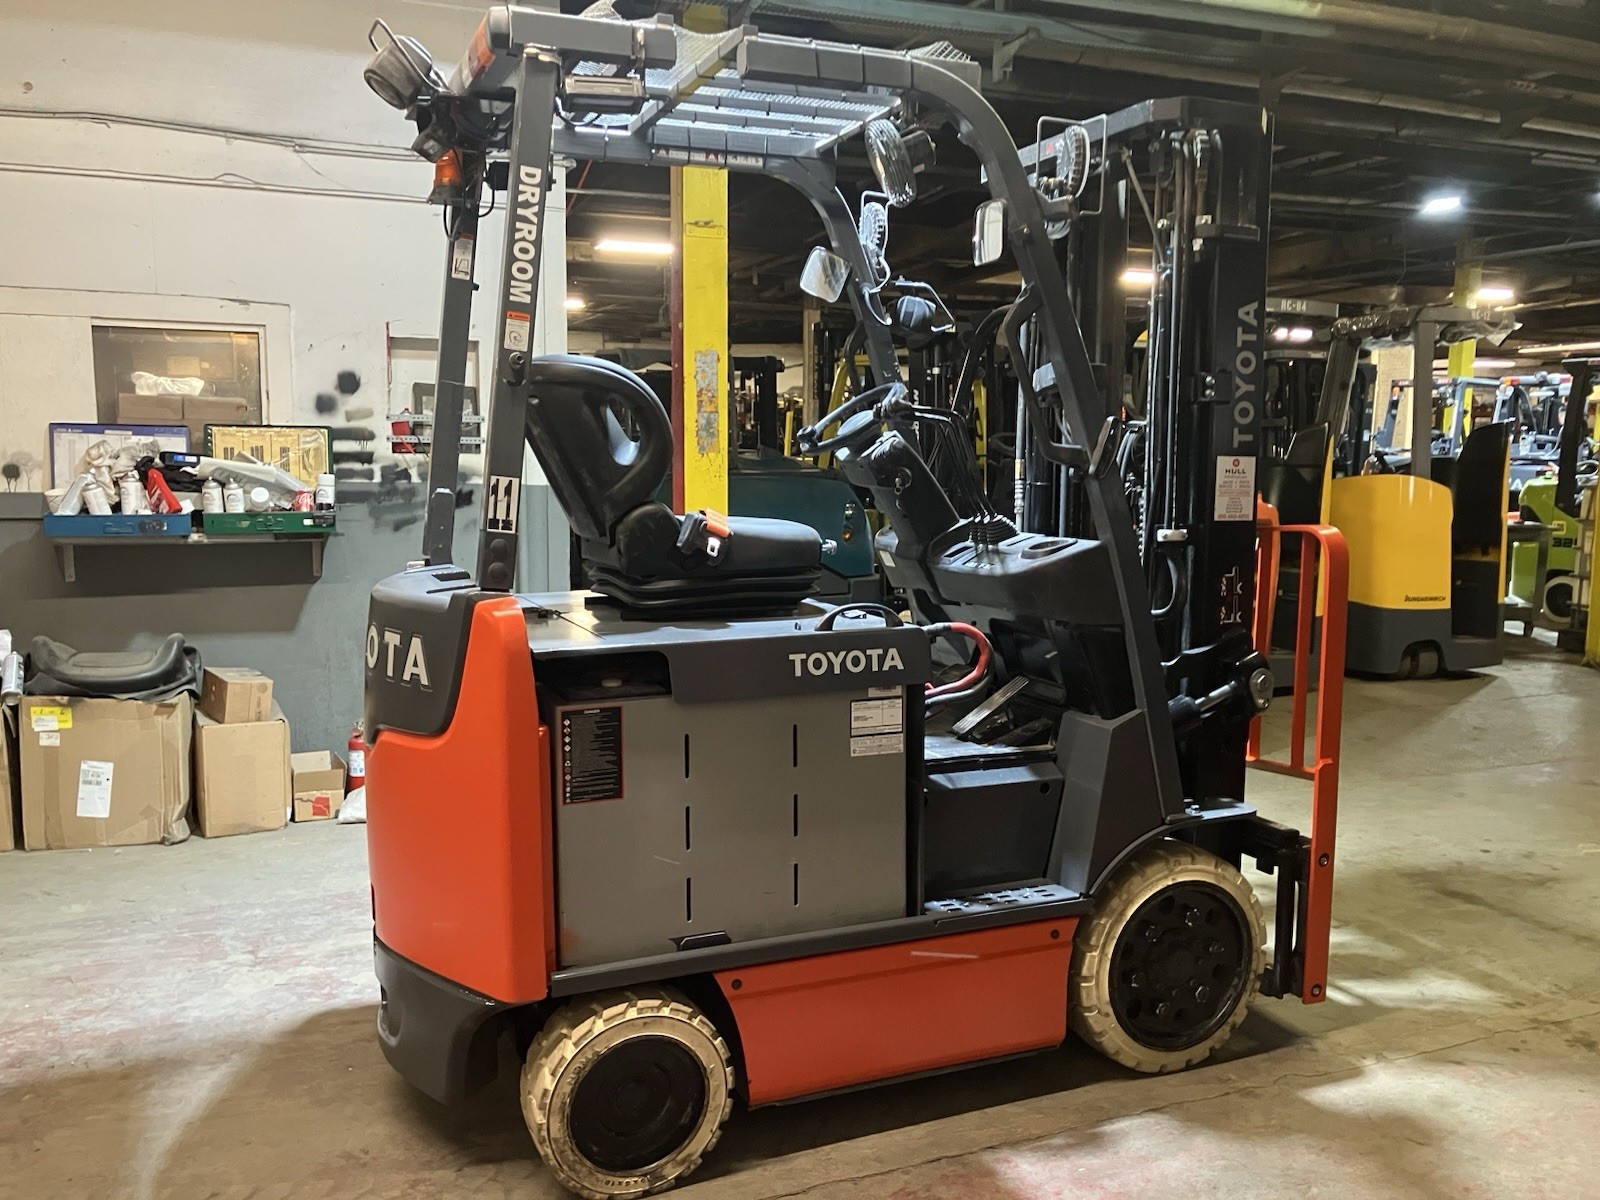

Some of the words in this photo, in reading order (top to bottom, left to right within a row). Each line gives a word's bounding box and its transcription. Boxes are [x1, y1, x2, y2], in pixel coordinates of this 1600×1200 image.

[509, 164, 542, 304] DRYROOM
[1232, 300, 1259, 449] TOYOTA
[488, 478, 513, 531] 11
[788, 647, 905, 677] TOYOTA
